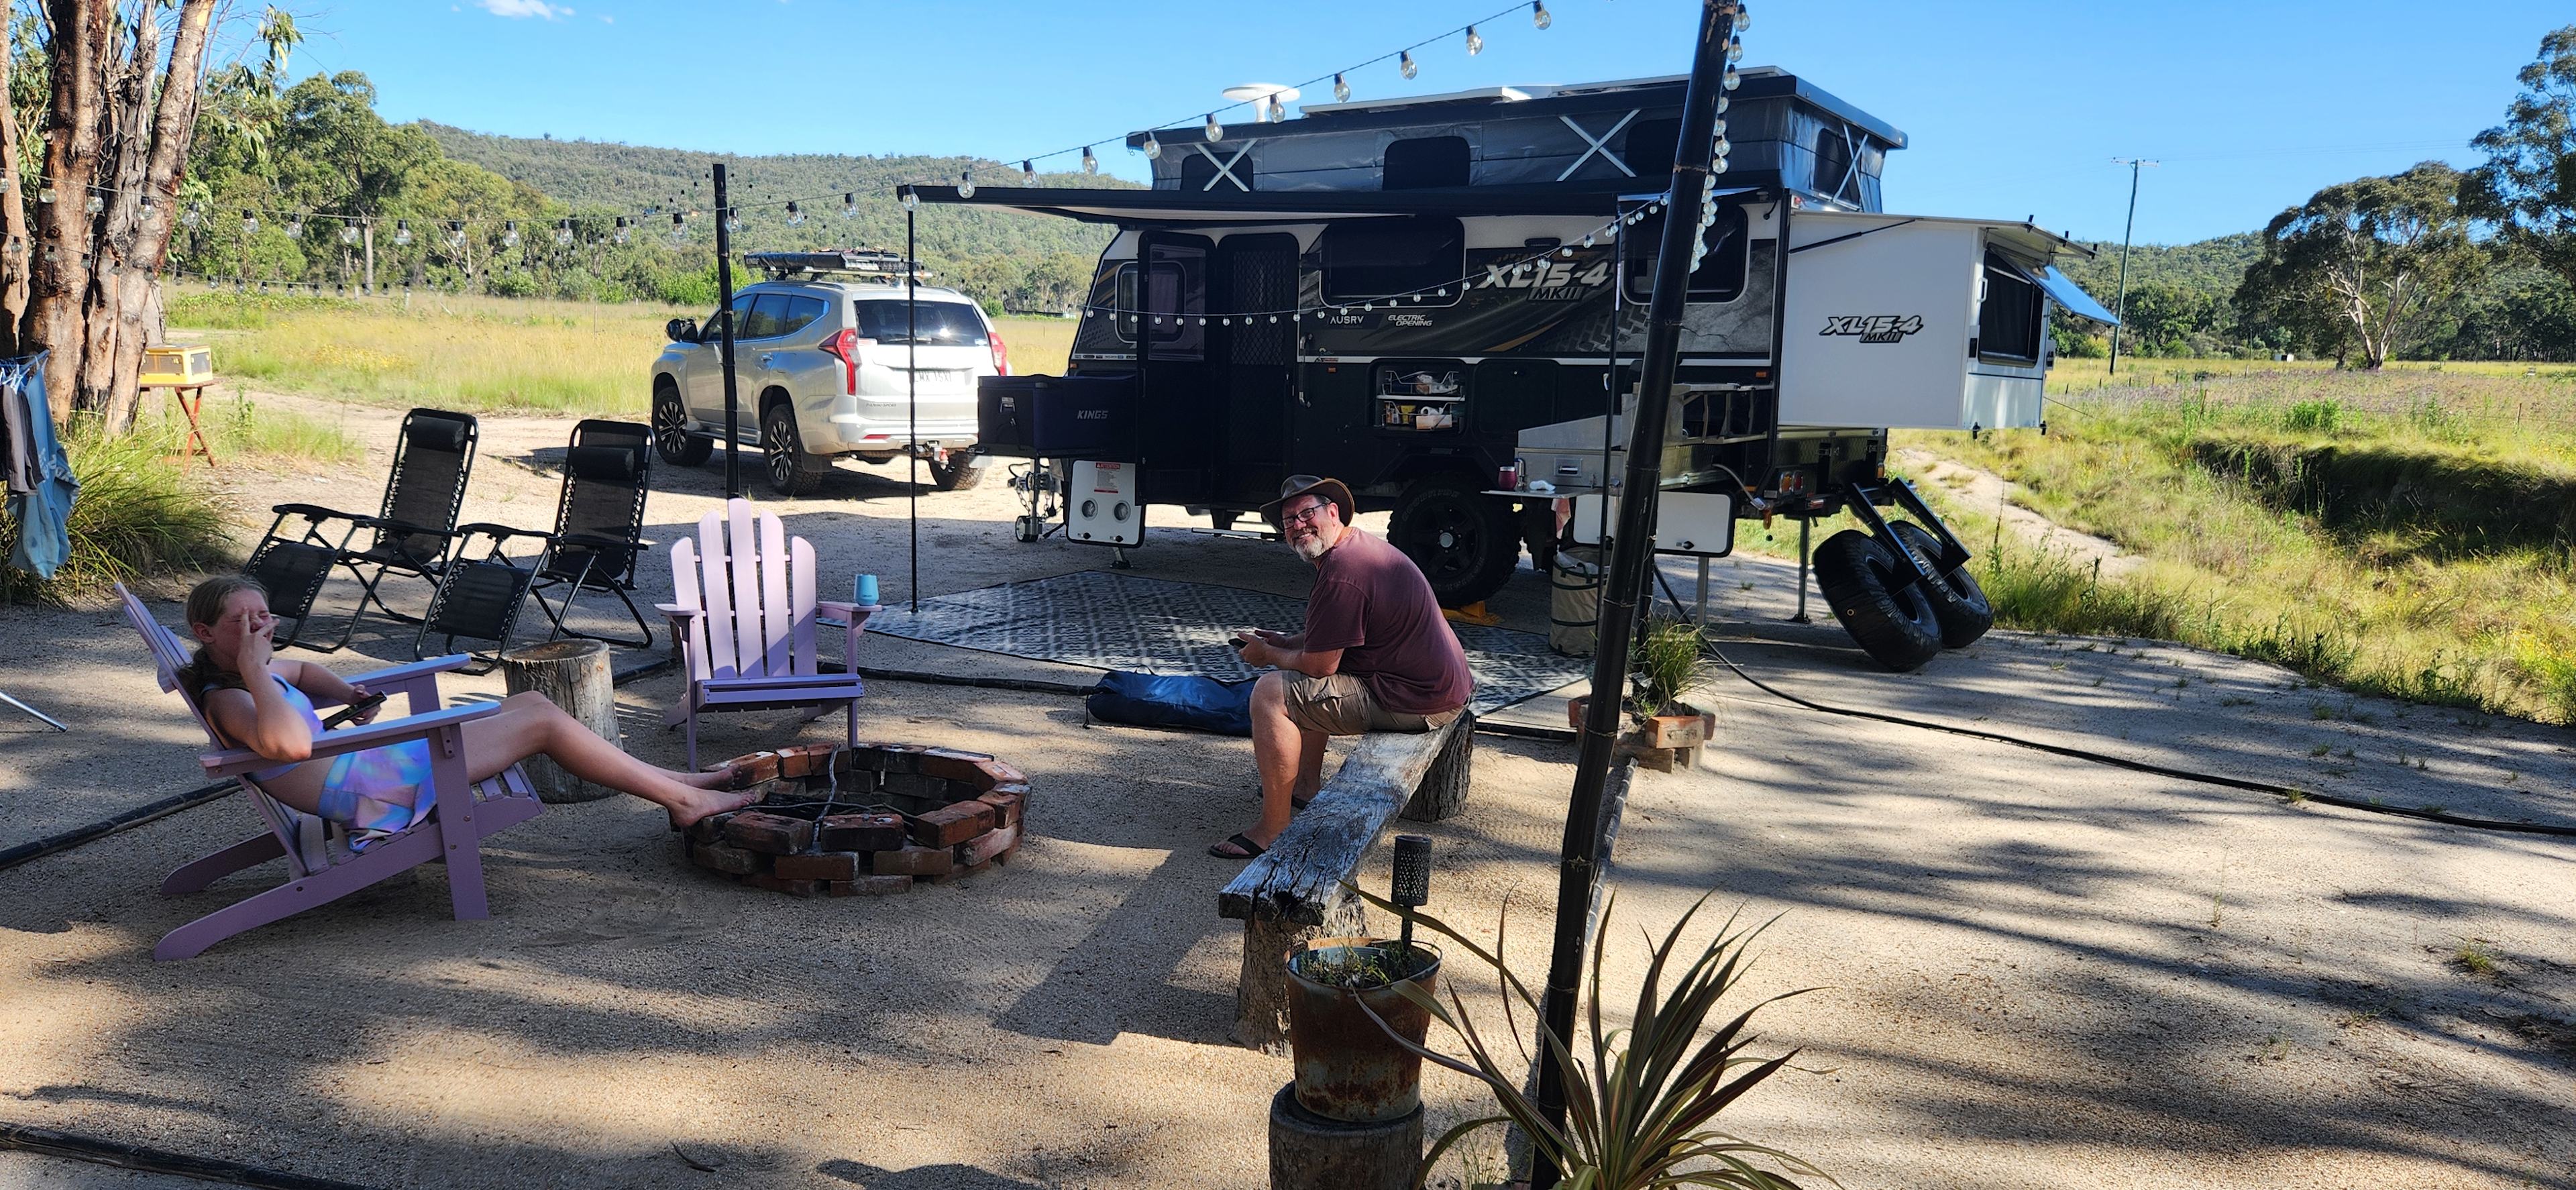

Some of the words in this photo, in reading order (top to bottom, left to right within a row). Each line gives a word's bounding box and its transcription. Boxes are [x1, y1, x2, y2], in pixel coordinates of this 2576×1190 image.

[1474, 262, 1608, 288] XL15-4
[1330, 315, 1364, 324] AUSRV
[1820, 315, 1923, 335] XL15-4
[1077, 410, 1109, 419] KINGS
